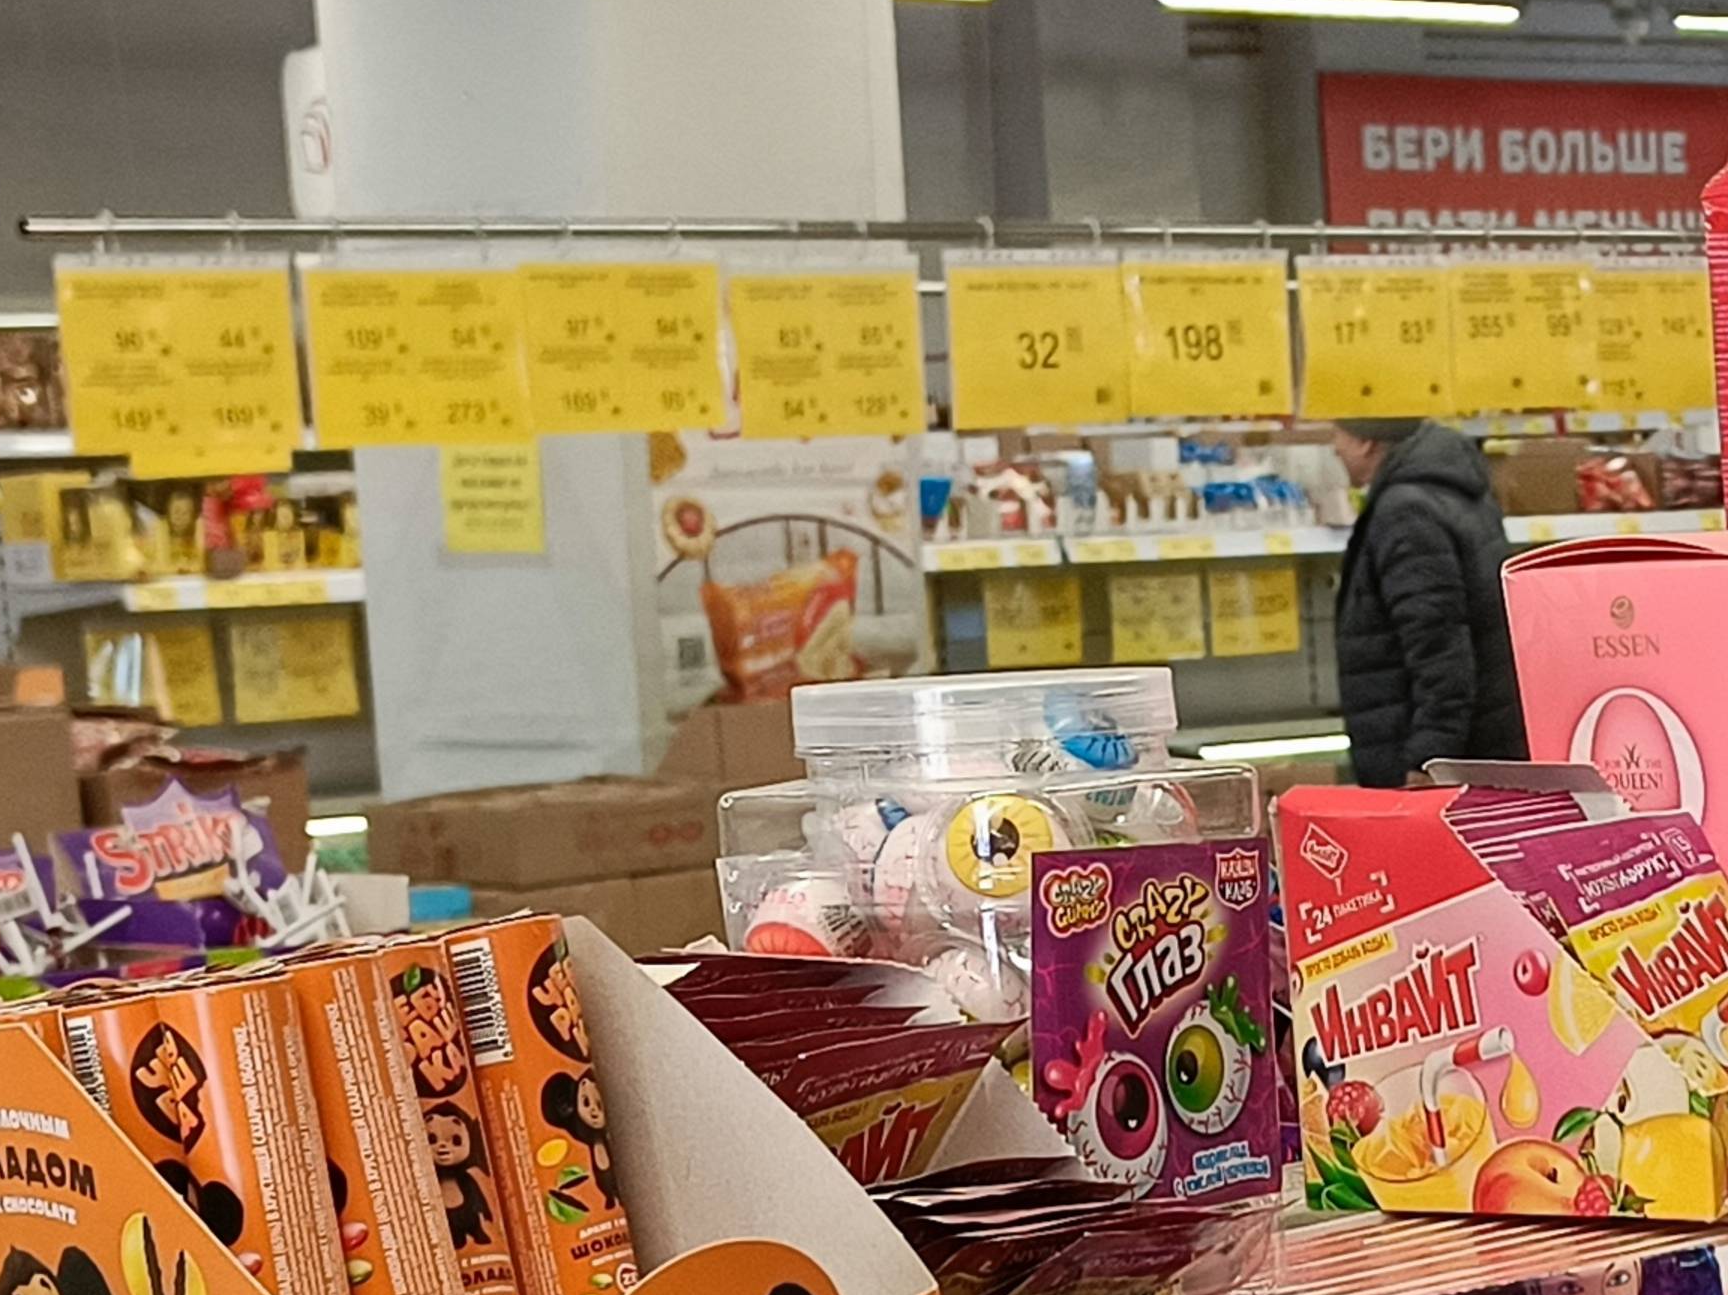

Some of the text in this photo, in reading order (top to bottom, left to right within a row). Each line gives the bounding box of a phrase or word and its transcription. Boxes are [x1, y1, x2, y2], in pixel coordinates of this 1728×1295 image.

[1362, 124, 1688, 174] БЕРИ БОЛЬШЕ
[1017, 332, 1060, 369] 32
[1166, 324, 1224, 361] 198
[1591, 632, 1661, 660] ESSEN
[1312, 905, 1332, 930] 24
